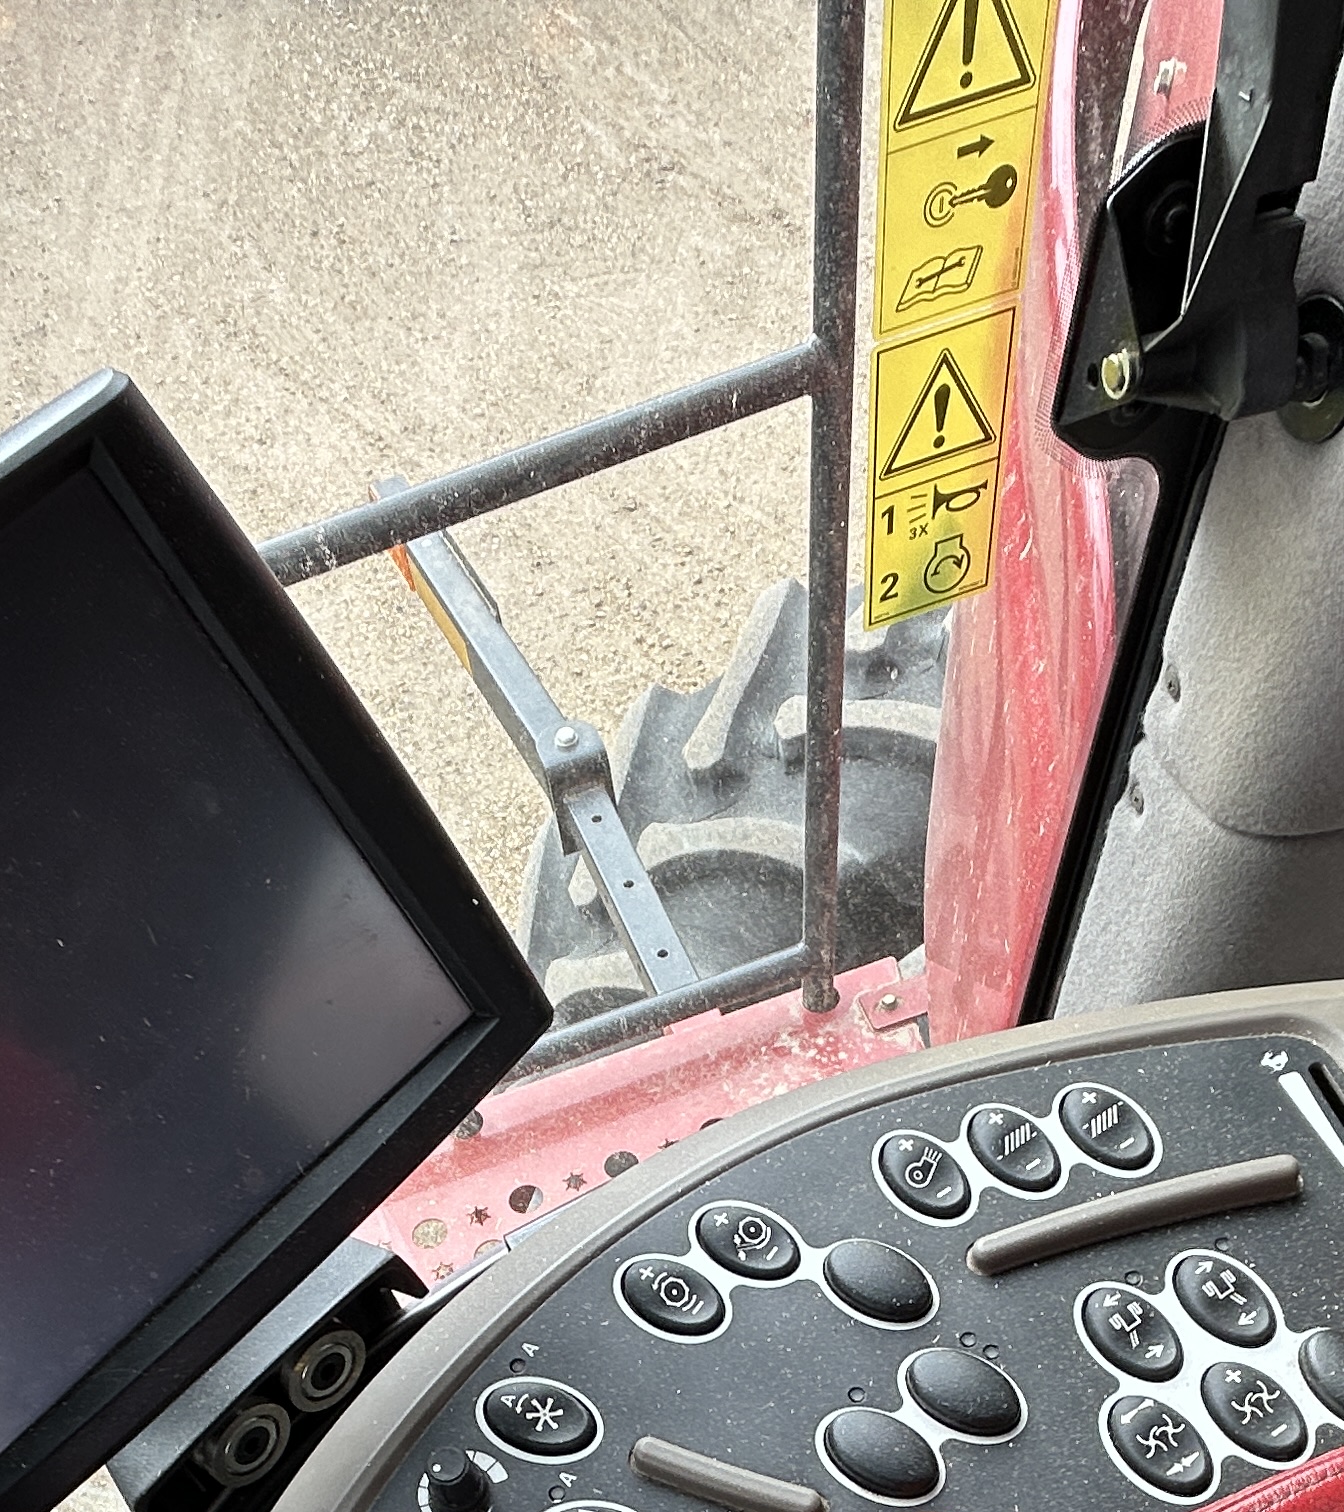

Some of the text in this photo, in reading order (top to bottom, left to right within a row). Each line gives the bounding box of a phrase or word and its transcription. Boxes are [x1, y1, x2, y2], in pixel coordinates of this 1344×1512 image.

[881, 505, 895, 535] 1
[879, 572, 899, 603] 2
[521, 1342, 540, 1357] A
[500, 1394, 517, 1408] A
[559, 1471, 578, 1488] A
